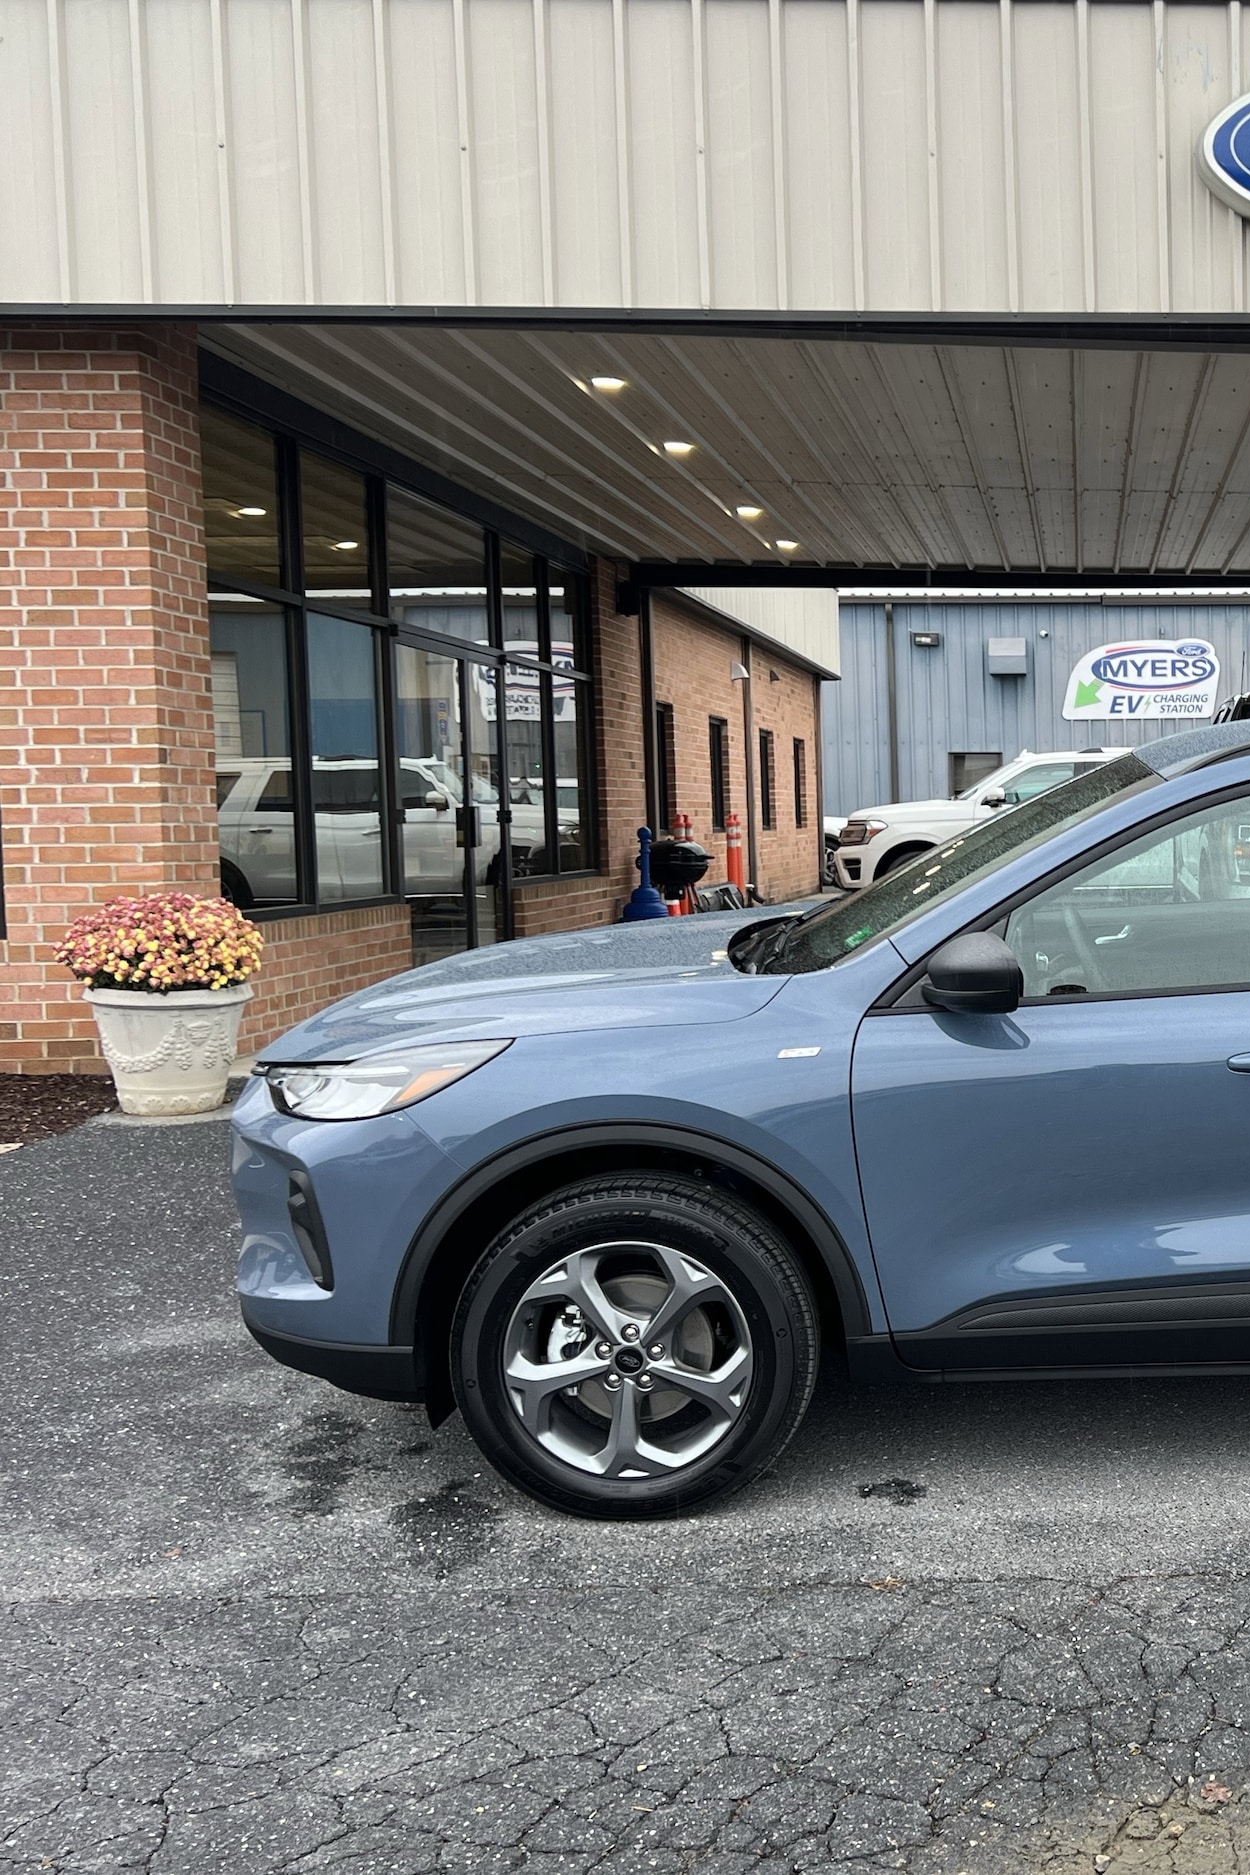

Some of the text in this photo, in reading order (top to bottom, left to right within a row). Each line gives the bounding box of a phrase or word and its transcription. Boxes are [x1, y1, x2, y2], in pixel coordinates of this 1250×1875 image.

[1181, 645, 1202, 656] Ford
[1102, 659, 1208, 678] MYERS
[1109, 695, 1145, 714] EV
[1153, 694, 1209, 704] CHARGING
[1160, 704, 1203, 714] STATION
